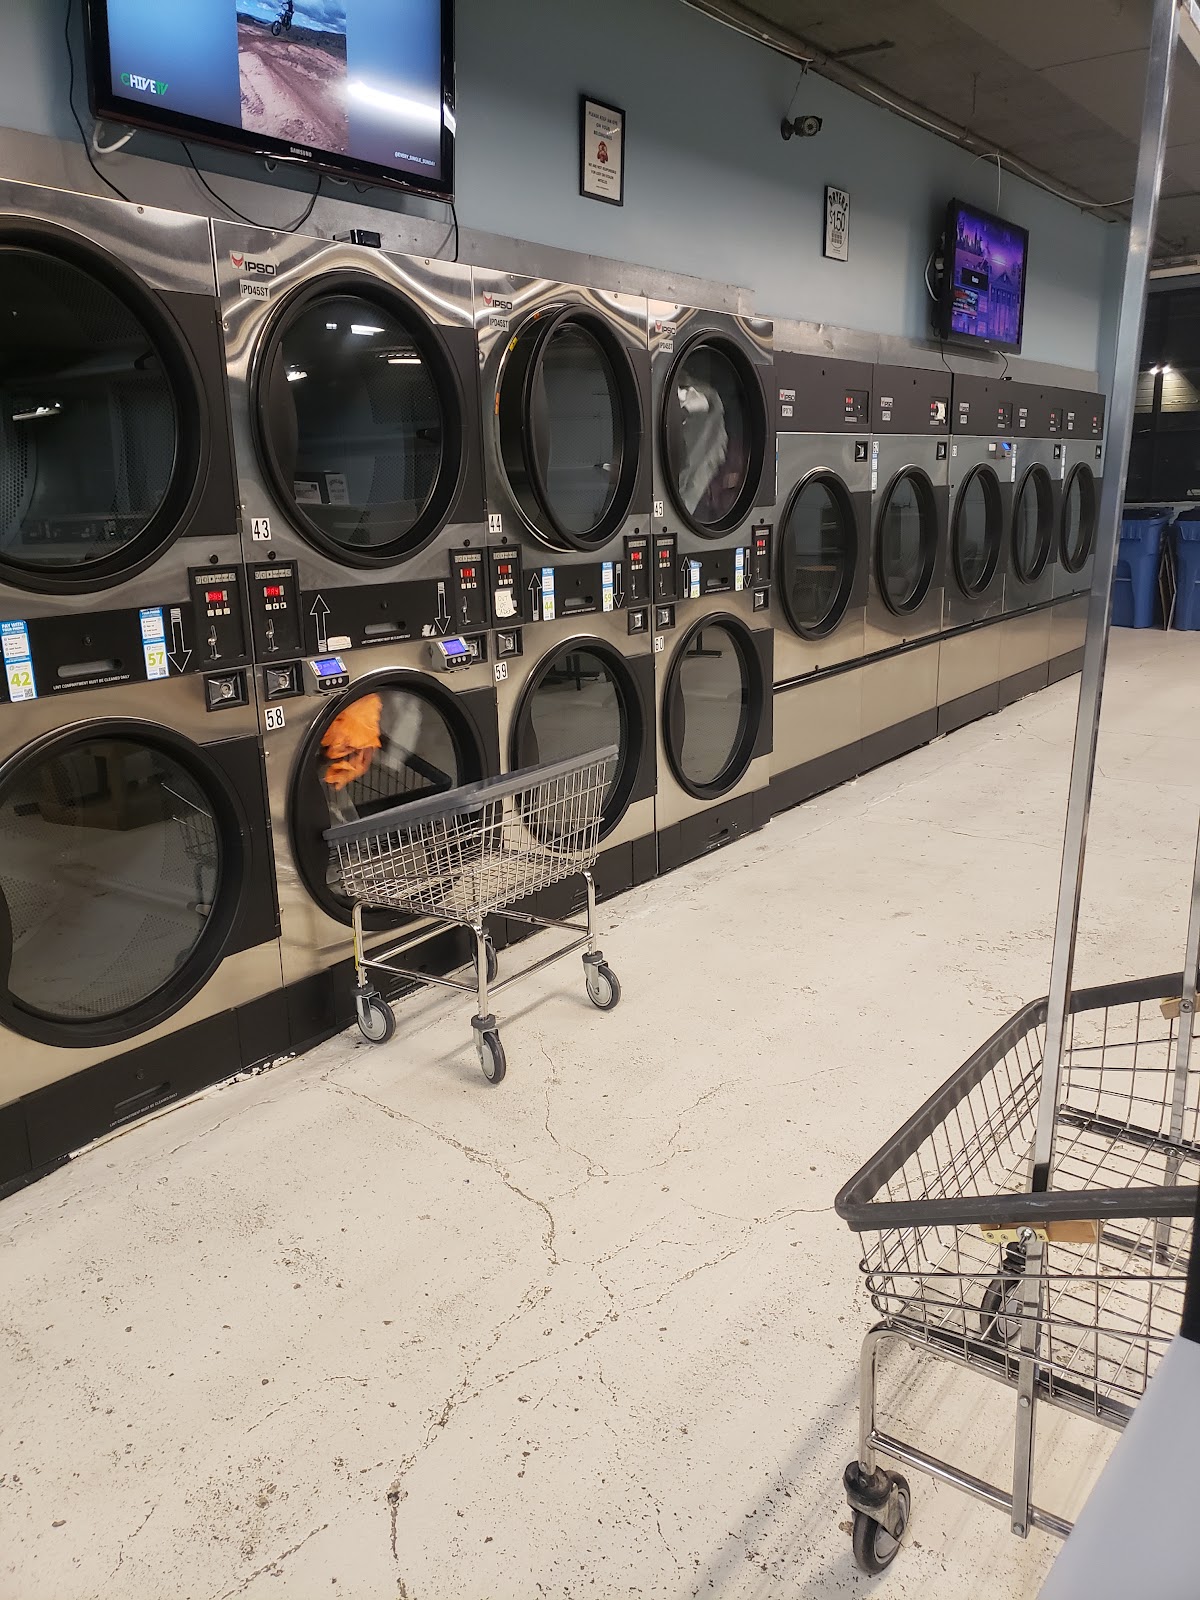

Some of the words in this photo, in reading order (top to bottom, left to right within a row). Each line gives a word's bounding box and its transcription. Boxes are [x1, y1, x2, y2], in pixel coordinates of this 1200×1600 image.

[828, 191, 848, 211] DRYERS
[245, 261, 274, 274] IPSO
[241, 284, 268, 297] IPD45ST
[492, 300, 512, 309] IPSO
[655, 502, 662, 516] 45
[254, 520, 269, 539] 43
[491, 515, 500, 531] 44
[545, 601, 553, 611] 44
[656, 637, 663, 650] 60
[148, 652, 164, 666] 57
[496, 664, 506, 679] 59
[11, 672, 32, 687] 42
[266, 709, 282, 727] 58
